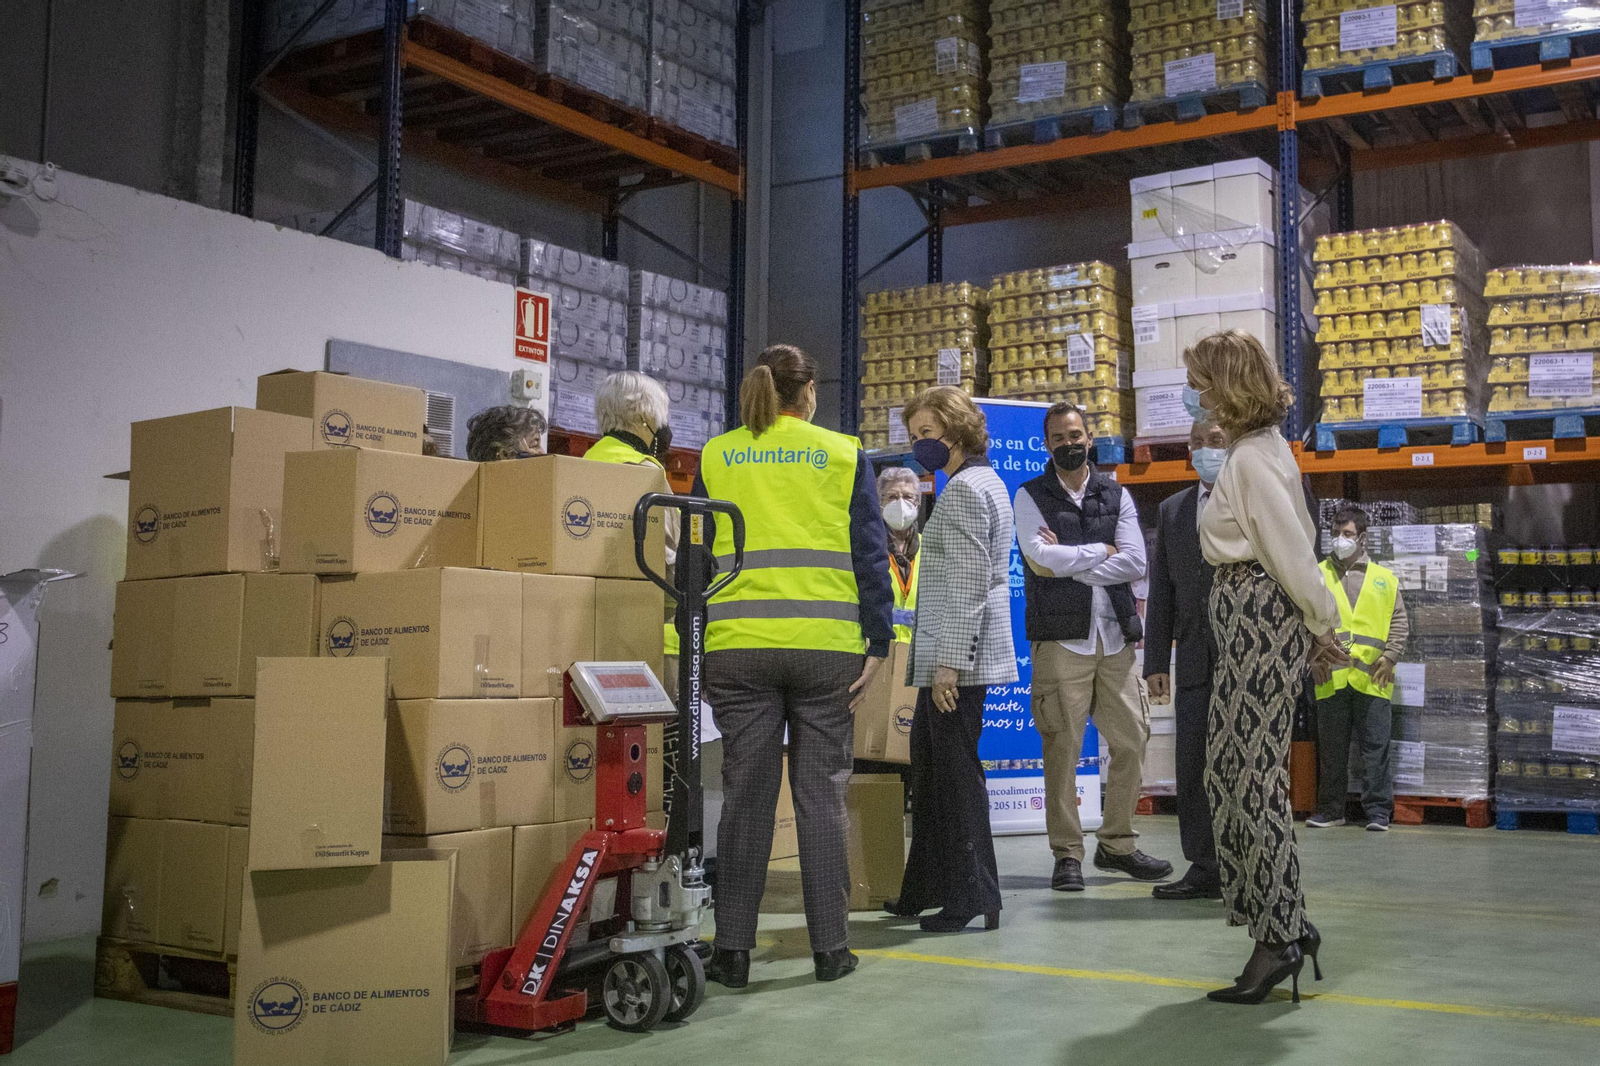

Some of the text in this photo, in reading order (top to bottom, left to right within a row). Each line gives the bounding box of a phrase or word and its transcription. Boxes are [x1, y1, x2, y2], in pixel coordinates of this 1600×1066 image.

[518, 345, 544, 356] EXTINTOR
[356, 424, 377, 432] BANCO
[386, 428, 417, 438] ALIMENTOS
[364, 433, 382, 441] CÁDIZ
[1006, 439, 1024, 450] en
[723, 447, 828, 469] Voluntari@
[1003, 455, 1021, 470] de
[163, 512, 182, 520] BANCO
[191, 507, 221, 517] ALIMENTOS
[404, 507, 471, 520] BANCO DE ALIMENTOS
[597, 511, 618, 520] BANCO
[627, 514, 659, 523] ALTOS
[414, 517, 432, 525] CÁDIZ
[606, 521, 624, 529] CÁDIZ
[361, 628, 383, 636] BANCO
[394, 625, 430, 634] ALIMENTOS
[690, 616, 700, 760] www.dinaksa.com
[983, 700, 1024, 713] mate,
[1016, 719, 1024, 731] y
[478, 754, 546, 764] BANCO DE ALIMENTOS
[488, 766, 508, 774] CÁDIZ
[994, 801, 1010, 810] 205
[1013, 800, 1027, 809] 151
[522, 850, 598, 996] DK DINAKSA
[312, 989, 430, 1001] BANCO DE ALIMENTOS
[312, 1002, 361, 1013] DE CÁDIZ
